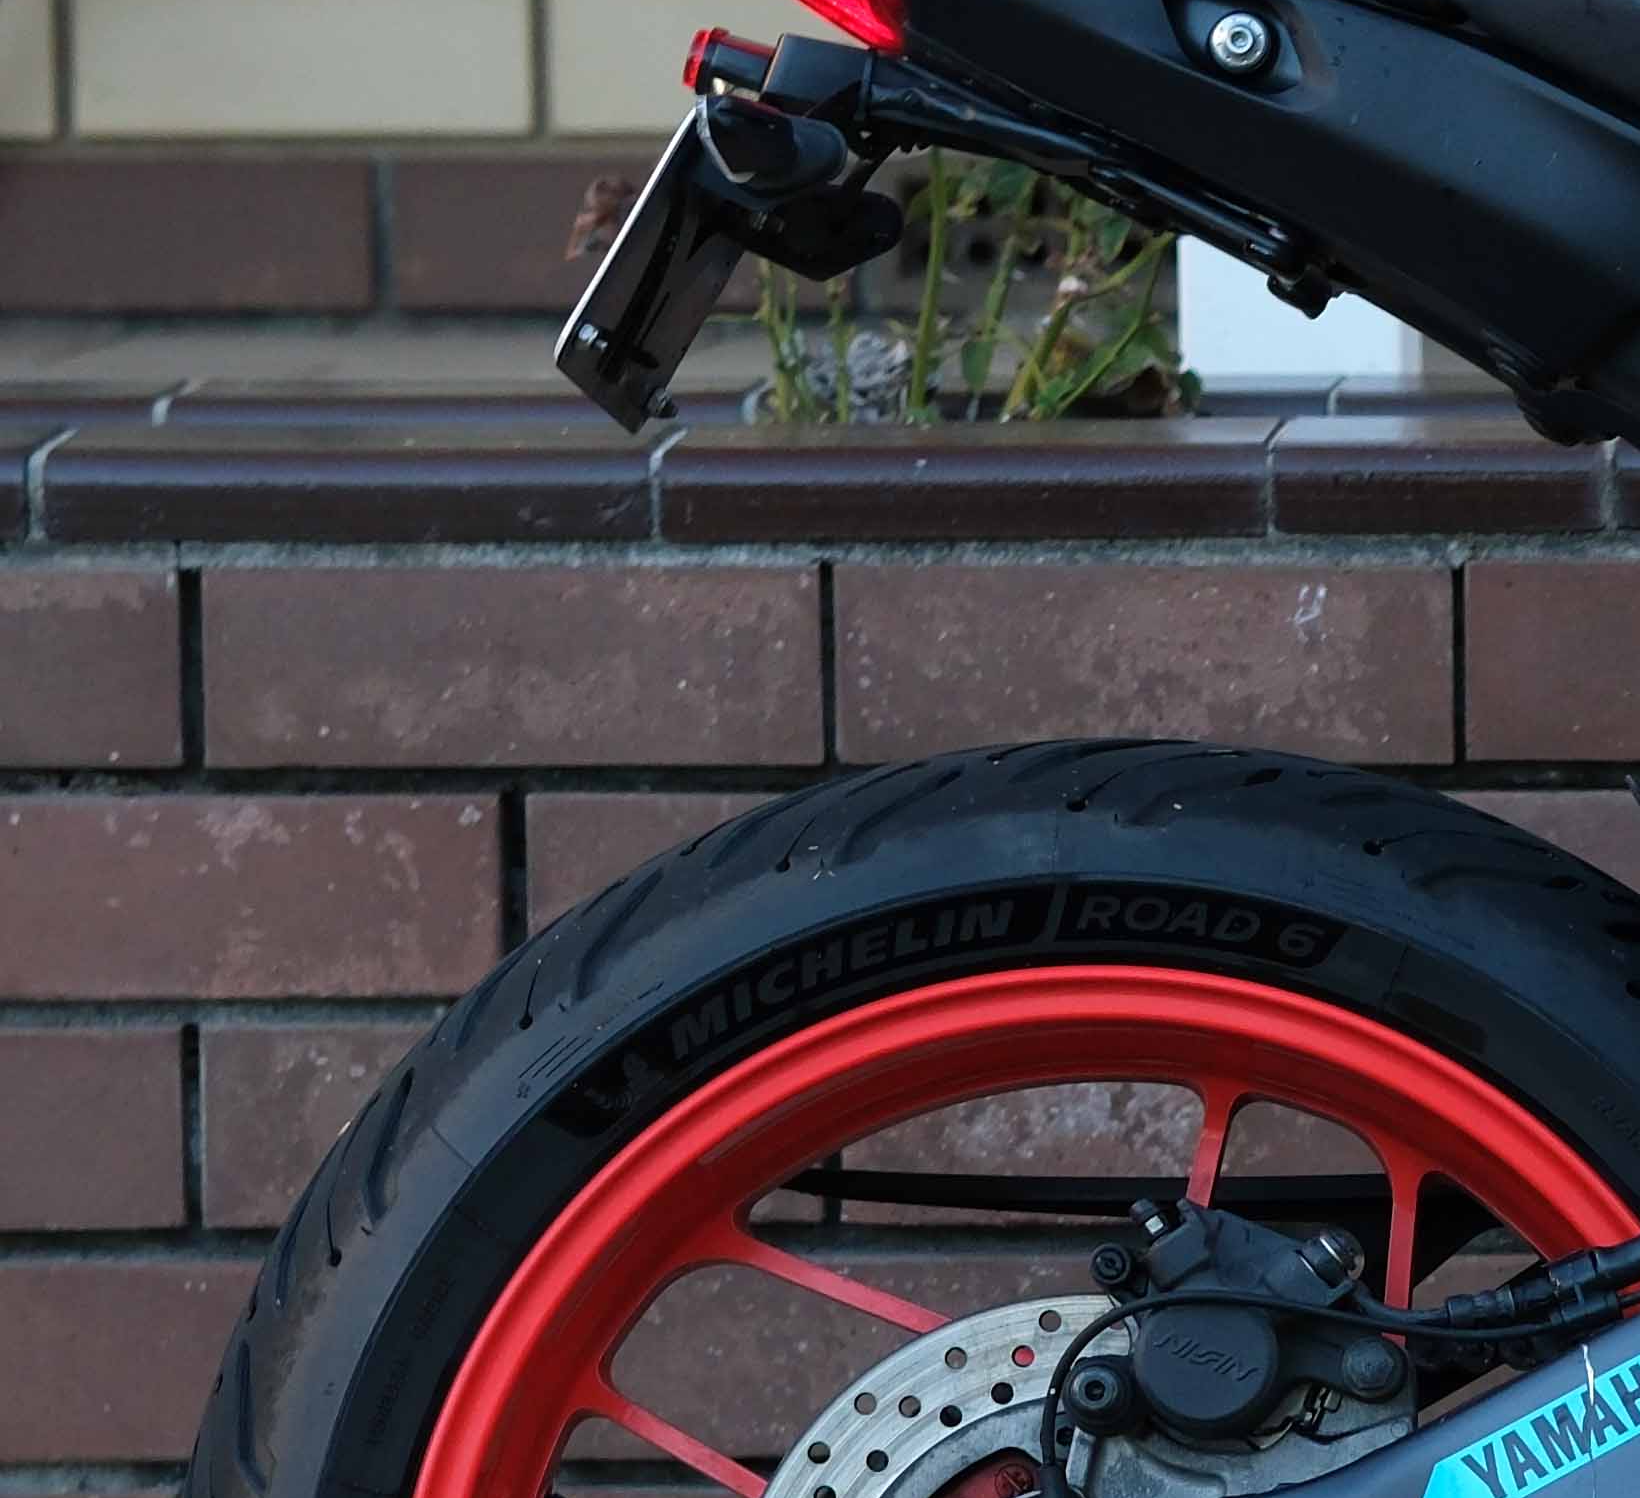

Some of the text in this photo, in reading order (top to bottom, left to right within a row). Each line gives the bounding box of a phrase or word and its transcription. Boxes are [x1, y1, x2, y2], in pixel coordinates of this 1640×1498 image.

[672, 896, 1325, 1060] MICHELIN ROAD 6
